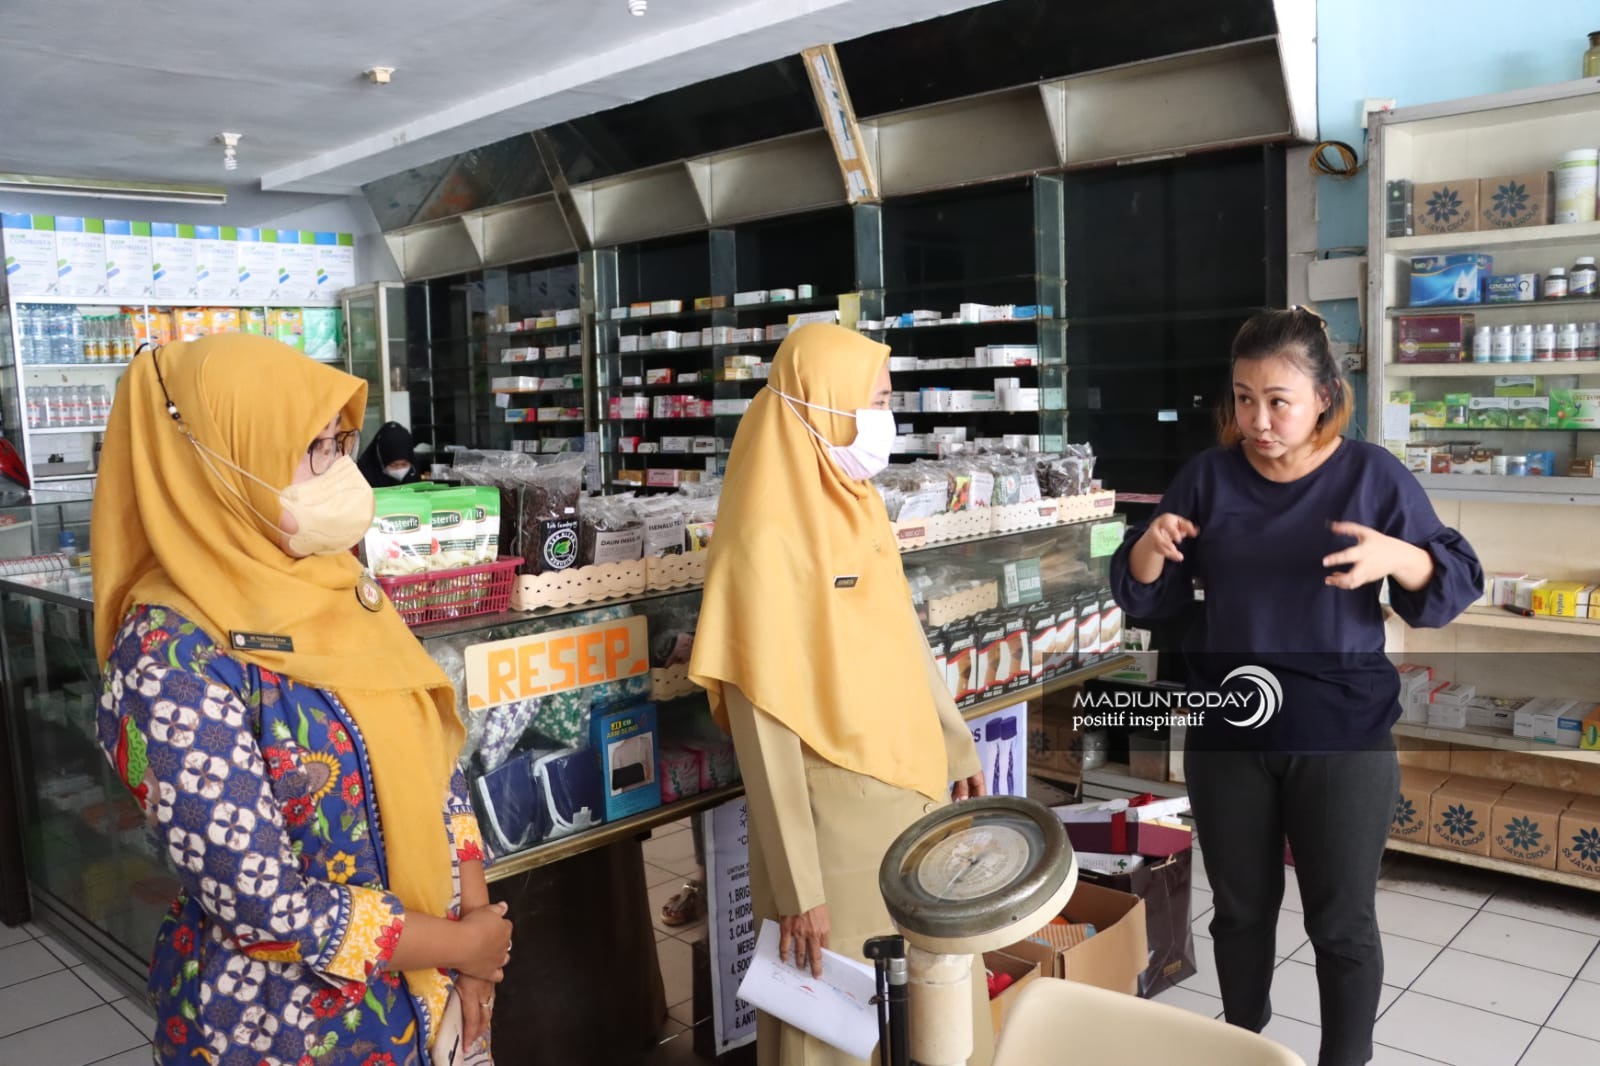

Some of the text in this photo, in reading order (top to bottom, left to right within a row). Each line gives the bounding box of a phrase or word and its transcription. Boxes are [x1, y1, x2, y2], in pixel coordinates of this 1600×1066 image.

[486, 626, 631, 703] RESEP
[734, 885, 751, 902] BRIG
[737, 937, 756, 956] MERE
[741, 1009, 756, 1027] ANTI
